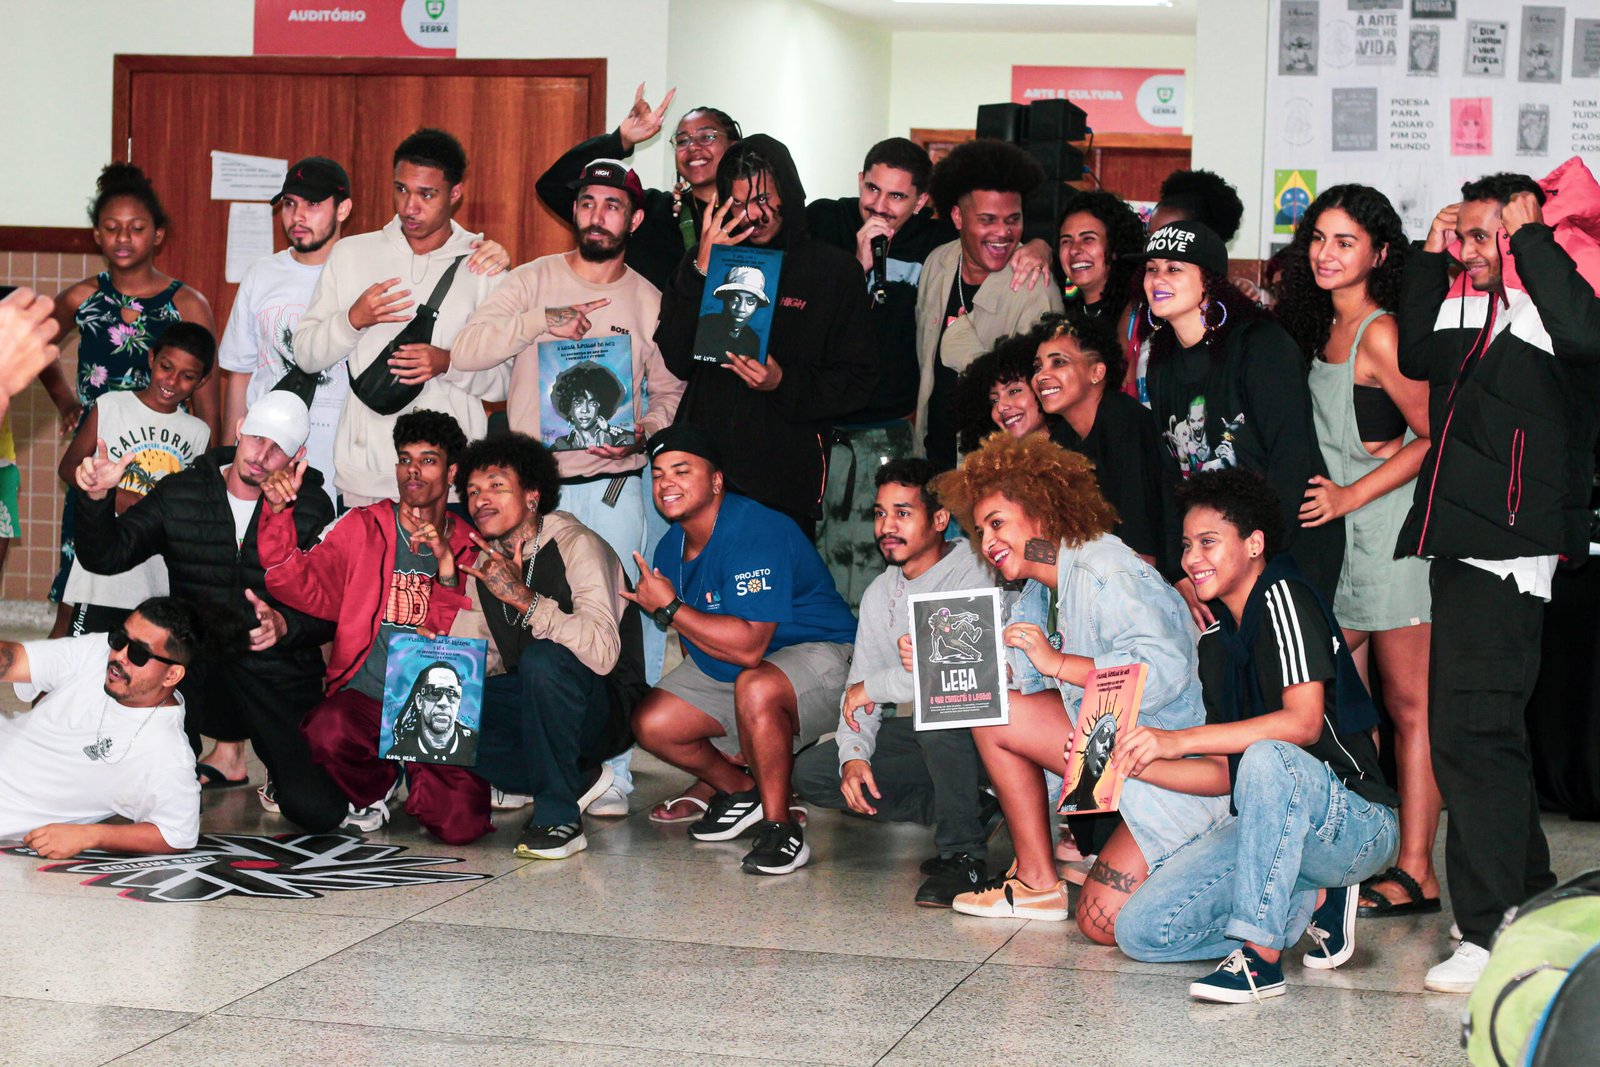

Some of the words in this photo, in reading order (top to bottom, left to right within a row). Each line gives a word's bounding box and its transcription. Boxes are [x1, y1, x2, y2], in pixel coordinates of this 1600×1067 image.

[288, 8, 366, 22] AUDITÓRIO
[1357, 15, 1365, 26] A
[1368, 15, 1398, 26] ARTE
[419, 25, 449, 33] SERRA
[1358, 39, 1398, 55] VIDA
[1024, 88, 1056, 99] ARTE
[1067, 89, 1125, 100] CULTURA
[1391, 109, 1420, 117] PARA
[1572, 122, 1589, 130] NO
[594, 169, 610, 177] HIGH
[1150, 226, 1196, 242] POWER
[1146, 239, 1188, 253] MOVE
[780, 297, 807, 310] HIGH
[110, 426, 194, 466] CALIFORNI
[734, 568, 771, 582] PROJETO
[940, 668, 979, 692] LEGA
